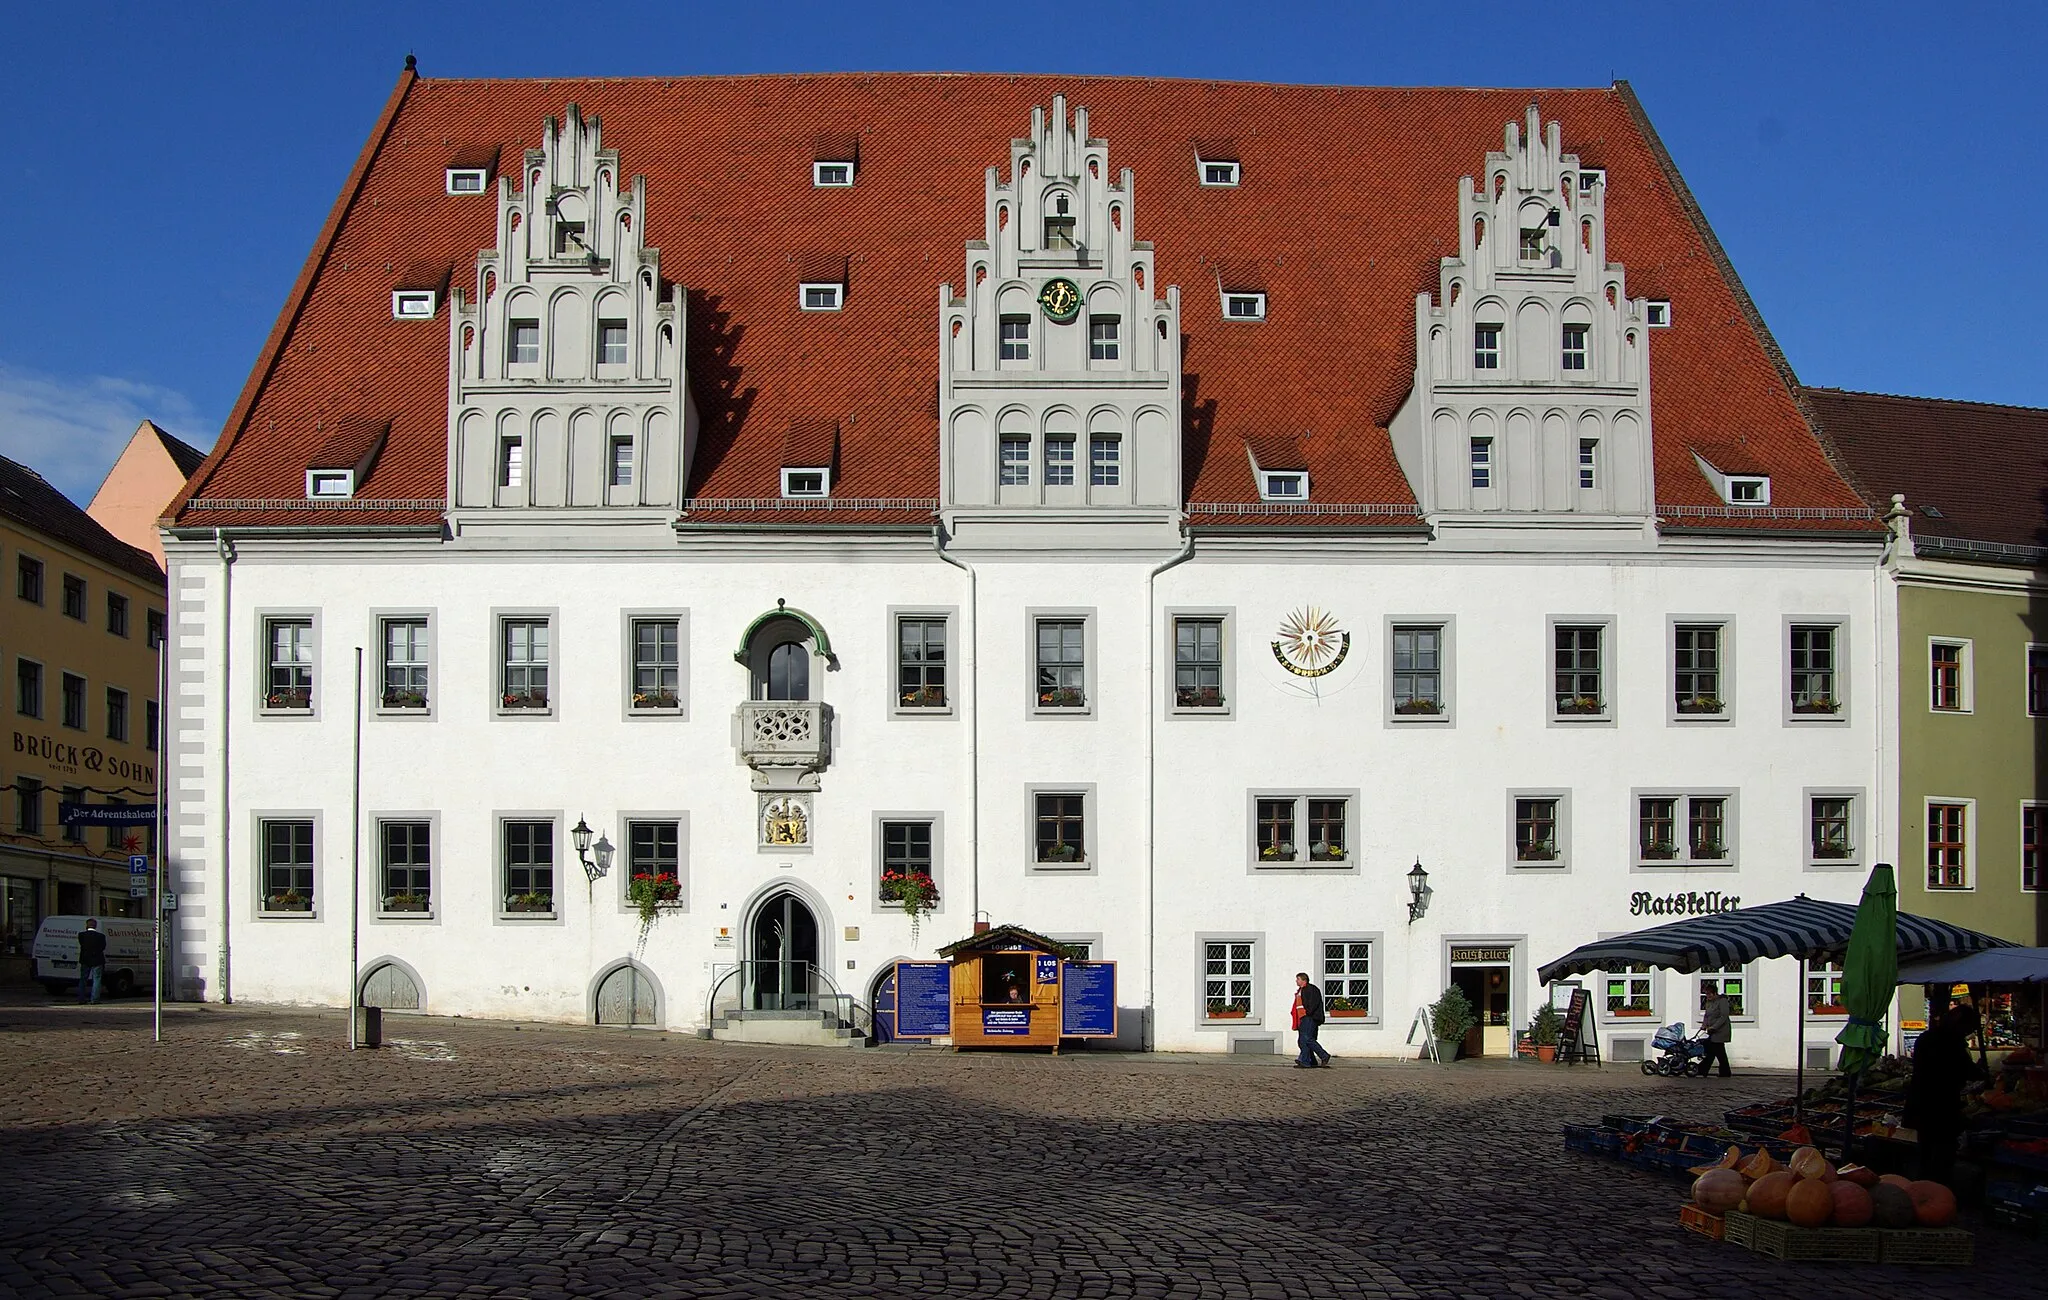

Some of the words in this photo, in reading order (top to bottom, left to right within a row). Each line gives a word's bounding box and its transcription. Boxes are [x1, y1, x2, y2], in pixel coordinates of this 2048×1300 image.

[13, 731, 78, 766] BRÜCK
[82, 747, 103, 772] &
[108, 757, 154, 784] SOHN
[49, 763, 61, 771] seit
[73, 808, 90, 818] Der
[92, 808, 157, 819] Adventskalend
[134, 858, 144, 872] P
[1629, 890, 1741, 916] Ratskeller
[1451, 949, 1509, 961] Ratskeller
